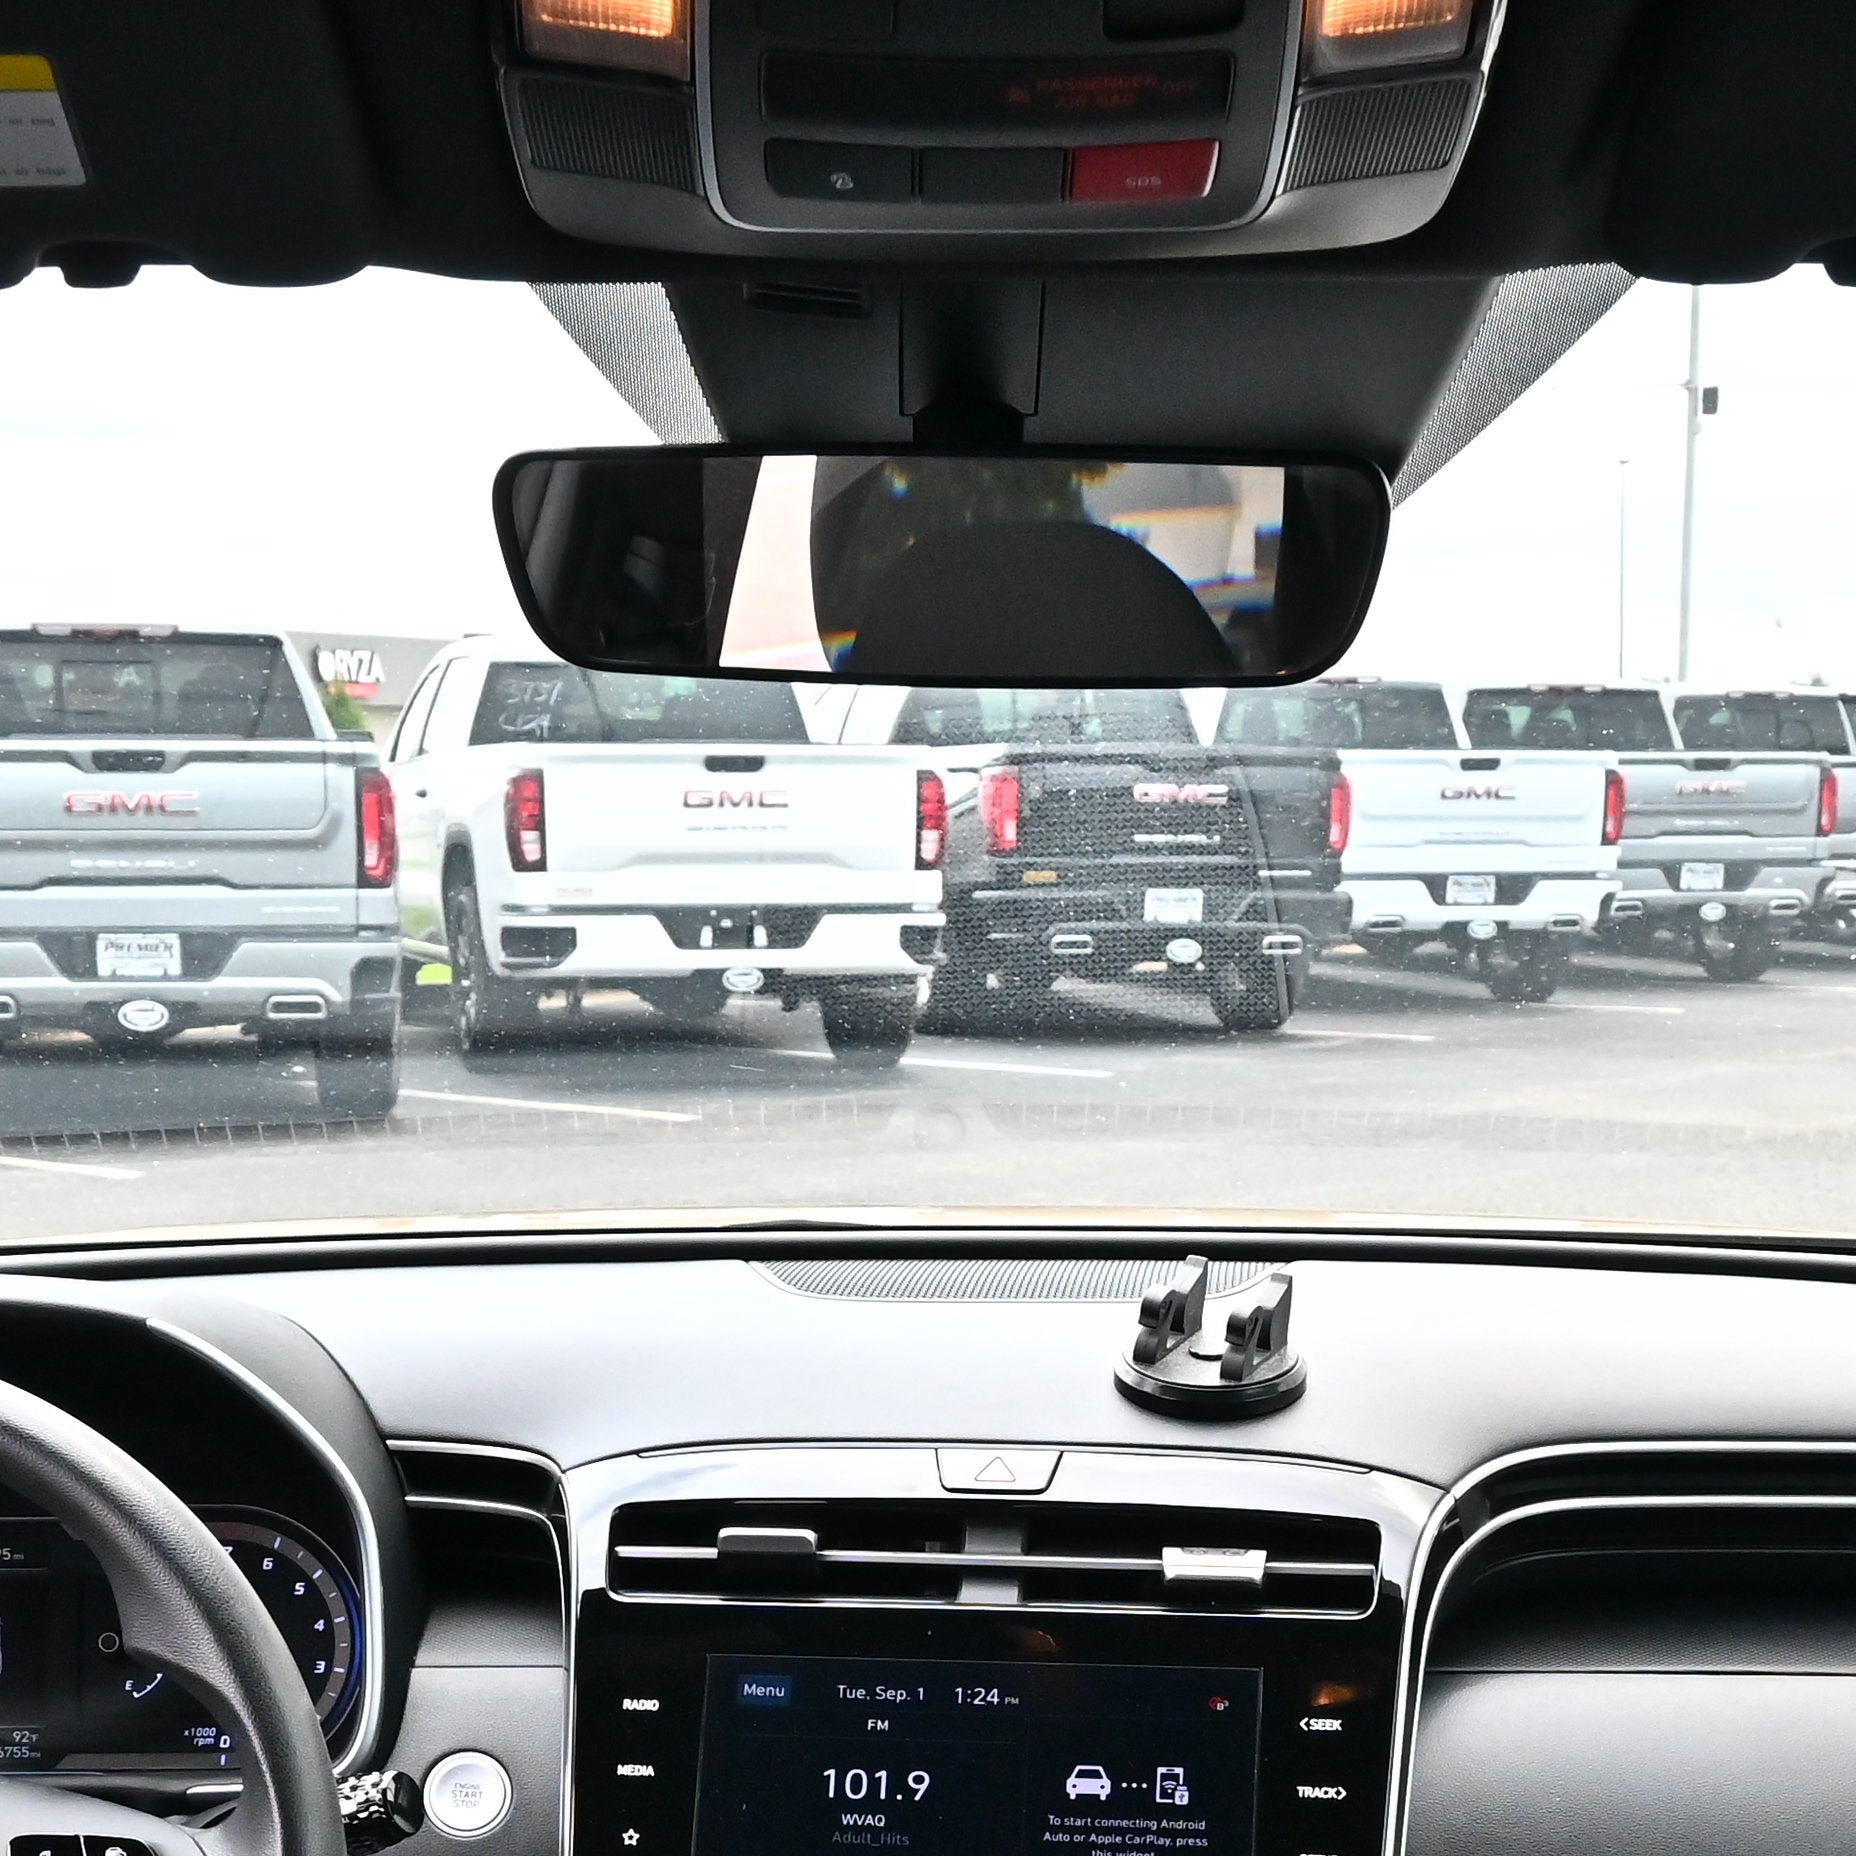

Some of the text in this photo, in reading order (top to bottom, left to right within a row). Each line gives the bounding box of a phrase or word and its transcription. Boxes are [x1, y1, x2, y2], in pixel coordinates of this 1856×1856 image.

[682, 790, 789, 808] GMC
[1133, 783, 1230, 805] GMC
[1440, 785, 1517, 801] GMC
[63, 790, 200, 816] GMC
[262, 1558, 274, 1571] 6
[293, 1582, 306, 1595] 5
[313, 1618, 325, 1632] 4
[313, 1660, 326, 1674] 3
[125, 1680, 134, 1691] E
[744, 1682, 1020, 1706] Menu Tue, Sep. 1 1:24 PM
[623, 1699, 660, 1711] RADIO
[867, 1719, 890, 1732] FM
[1309, 1718, 1342, 1731] SEEK
[184, 1727, 216, 1737] x1000
[193, 1735, 231, 1749] rpm 0
[617, 1763, 655, 1777] MEDIA
[823, 1767, 931, 1801] 101.9
[451, 1790, 483, 1799] START
[1296, 1785, 1338, 1799] TRACK
[453, 1799, 479, 1809] STOP
[841, 1813, 886, 1828] WVAQ
[1048, 1814, 1207, 1831] To start connecting Android
[831, 1831, 910, 1848] Adult_Hits
[1043, 1831, 1210, 1848] Auto or Apple CarPlay, press
